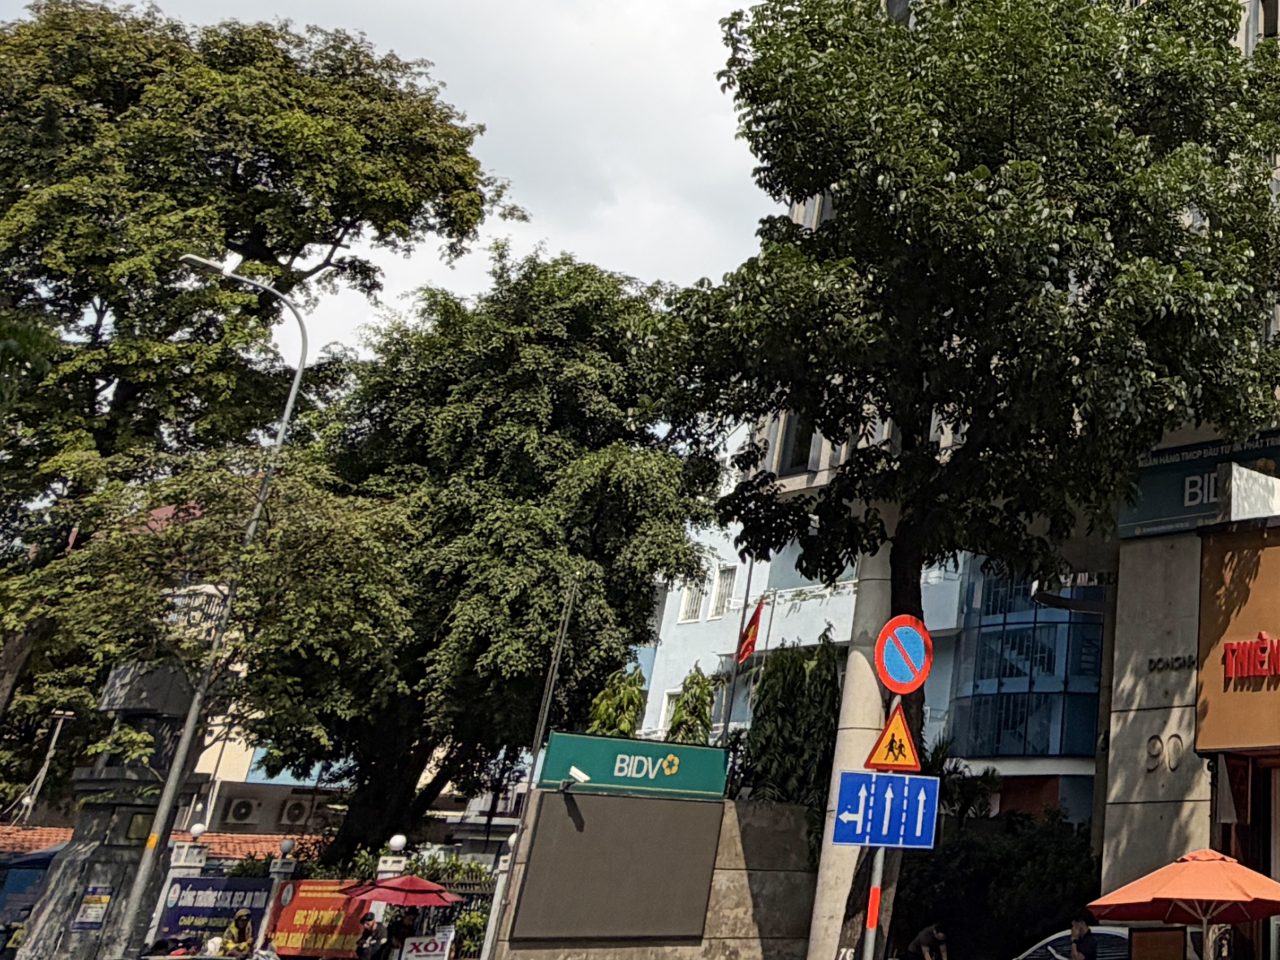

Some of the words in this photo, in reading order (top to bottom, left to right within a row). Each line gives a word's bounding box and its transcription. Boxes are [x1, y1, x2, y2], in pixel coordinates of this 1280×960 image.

[1181, 448, 1203, 463] TMCP
[613, 753, 664, 780] BIDV
[1146, 734, 1184, 774] 90
